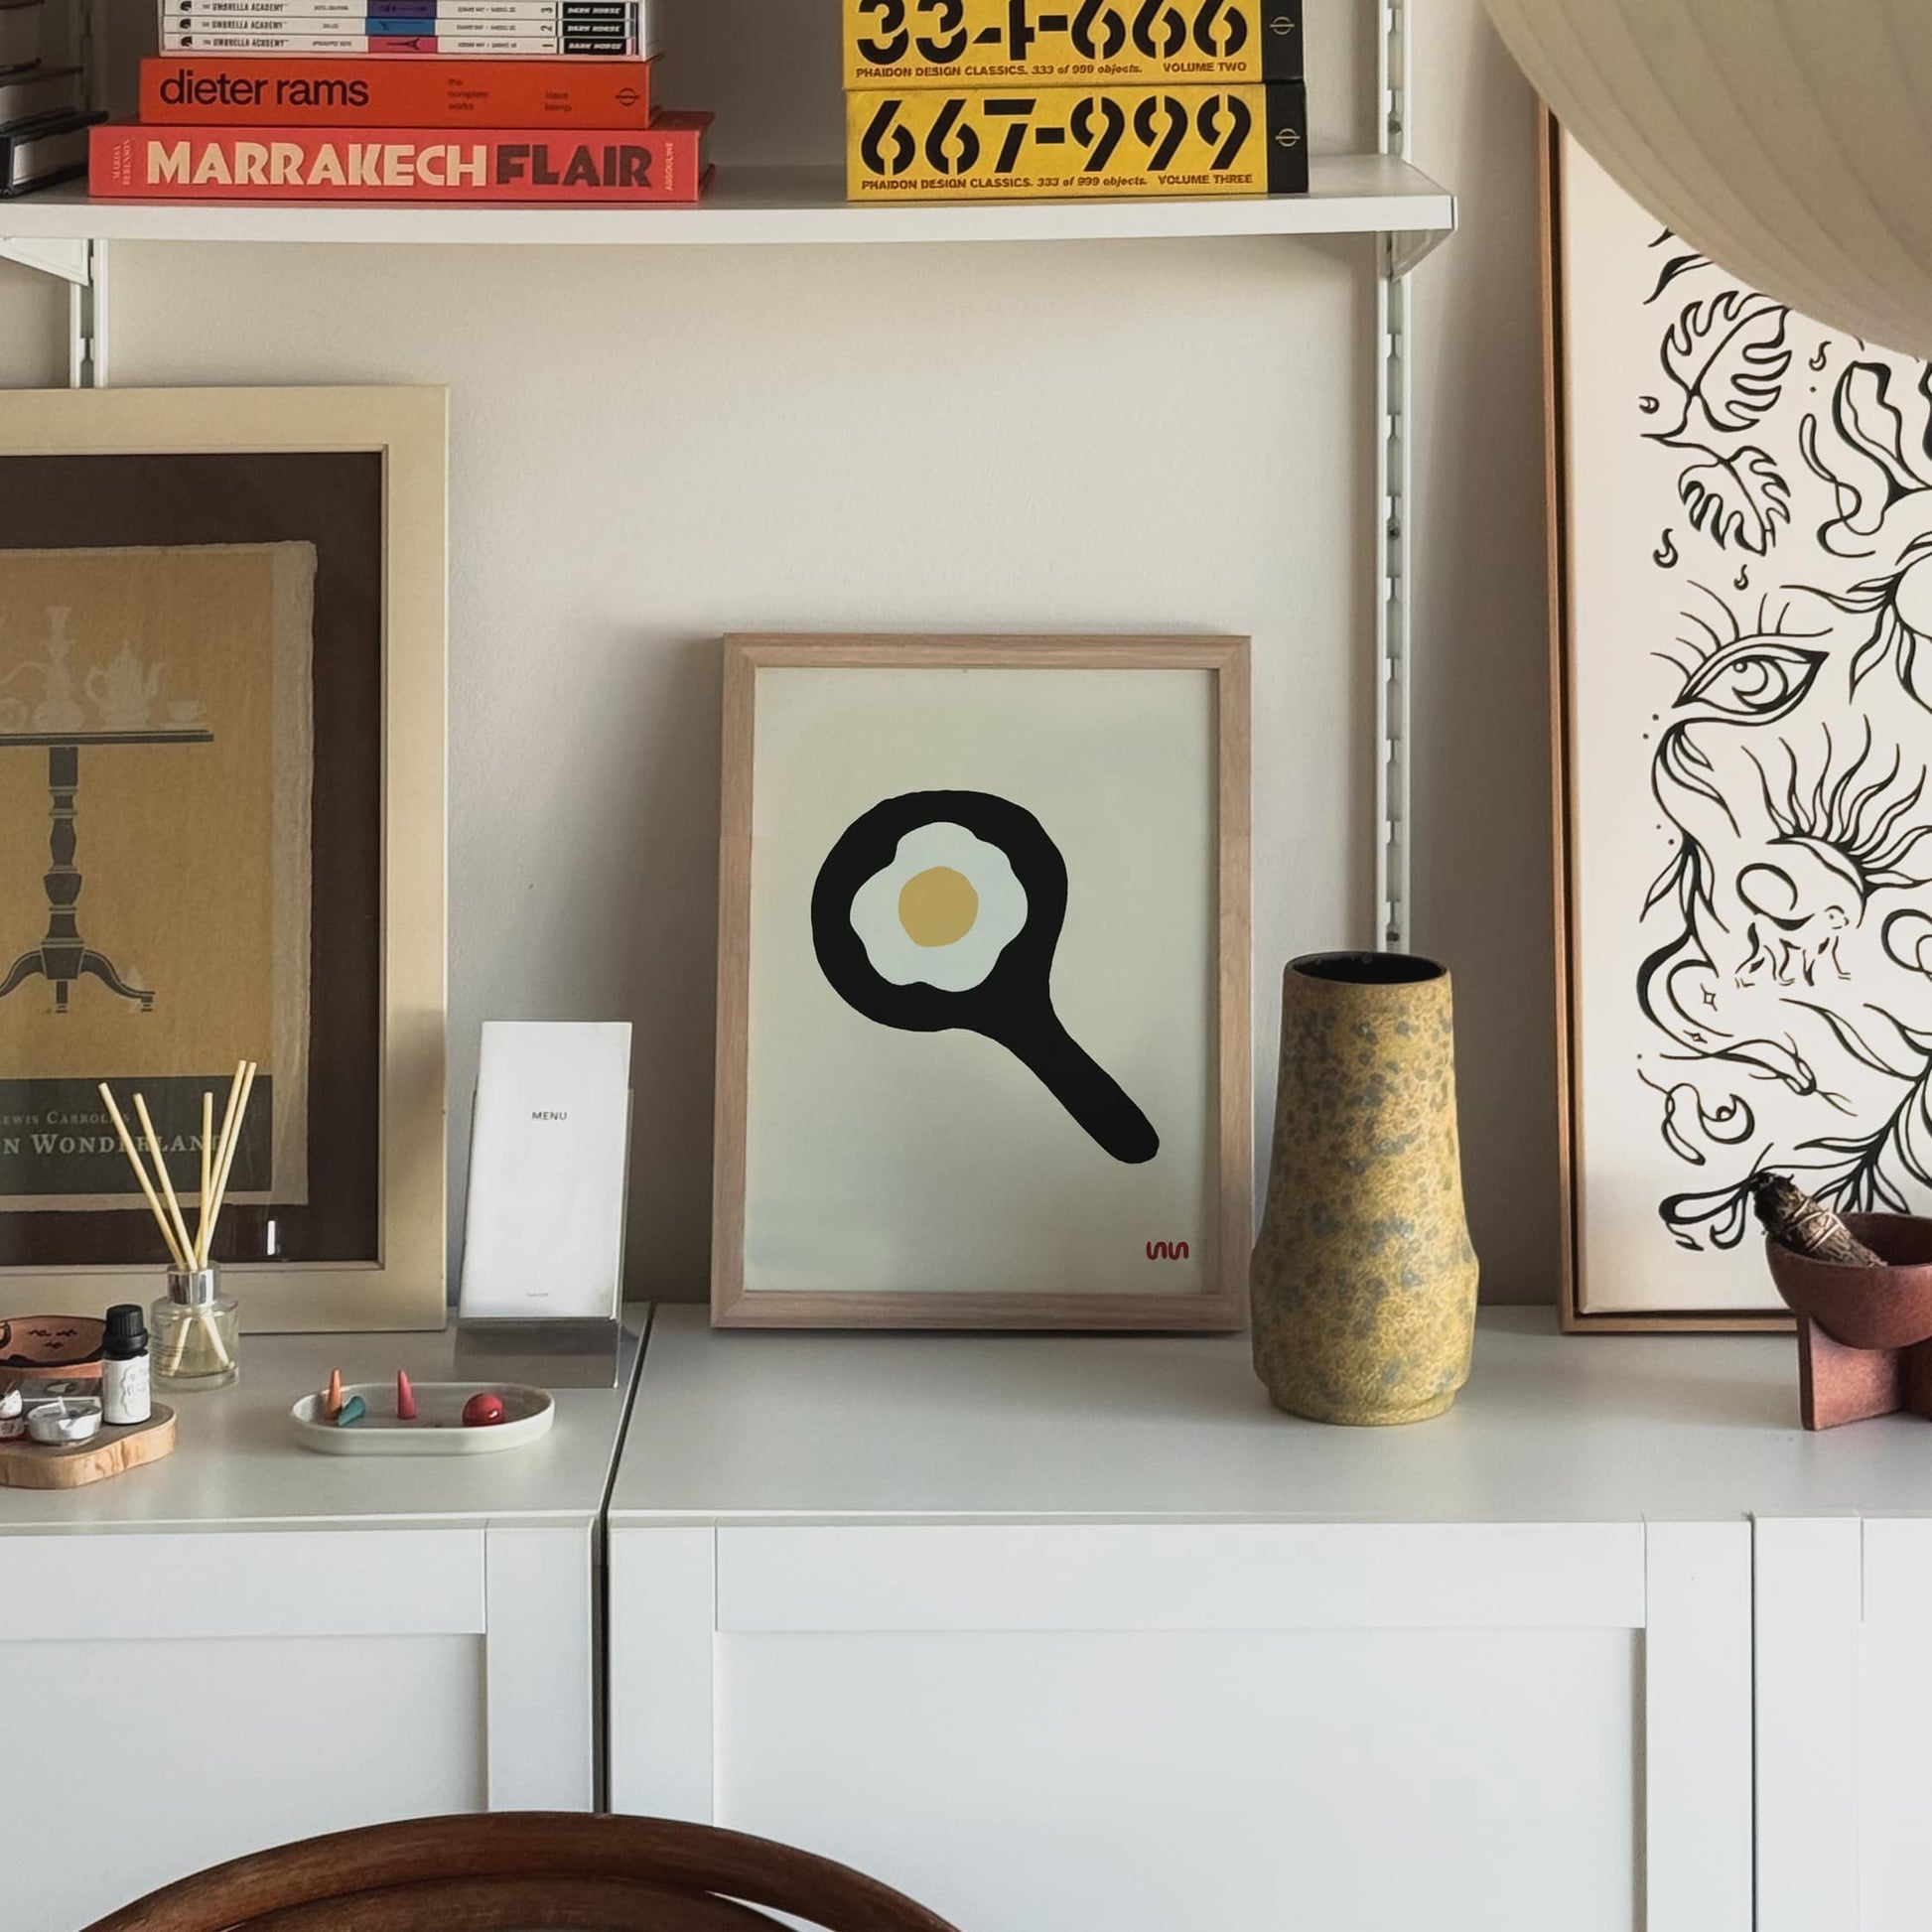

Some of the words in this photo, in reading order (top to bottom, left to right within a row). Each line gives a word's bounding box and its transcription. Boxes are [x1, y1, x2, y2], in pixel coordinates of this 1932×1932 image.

[212, 2, 248, 12] UMBRELLA
[250, 2, 284, 12] ACADEMY
[211, 20, 248, 29] UMBRELLA
[250, 20, 284, 30] ACADEMY
[857, 0, 1247, 65] 334-666
[212, 38, 250, 47] UMBRELLA
[251, 38, 285, 48] ACADEMY
[856, 68, 912, 77] PHAIDON
[915, 66, 961, 76] DESIGN
[964, 66, 1029, 75] CLASSICS.
[1032, 66, 1054, 75] 333
[1057, 64, 1070, 73] of
[1072, 64, 1094, 73] 999
[1097, 64, 1143, 75] objects.
[1164, 62, 1214, 73] VOLUME
[1218, 62, 1247, 71] TWO
[159, 69, 269, 105] dieter
[276, 77, 369, 106] rams
[861, 93, 1252, 176] 667-999
[147, 141, 487, 187] MARRAKECH
[496, 144, 652, 187] FLAIR
[862, 179, 917, 190] PHAIDON
[921, 179, 967, 189] DESIGN
[970, 178, 1034, 188] CLASSICS.
[1036, 177, 1059, 187] 333
[1062, 177, 1074, 187] of
[1077, 177, 1100, 186] 999
[1102, 175, 1148, 188] objects.
[1158, 175, 1210, 185] VOLUME
[1213, 174, 1253, 185] THREE
[0, 1114, 39, 1126] EWIS
[46, 1110, 131, 1125] CARROLS
[532, 1111, 568, 1121] MENU
[2, 1138, 21, 1155] N
